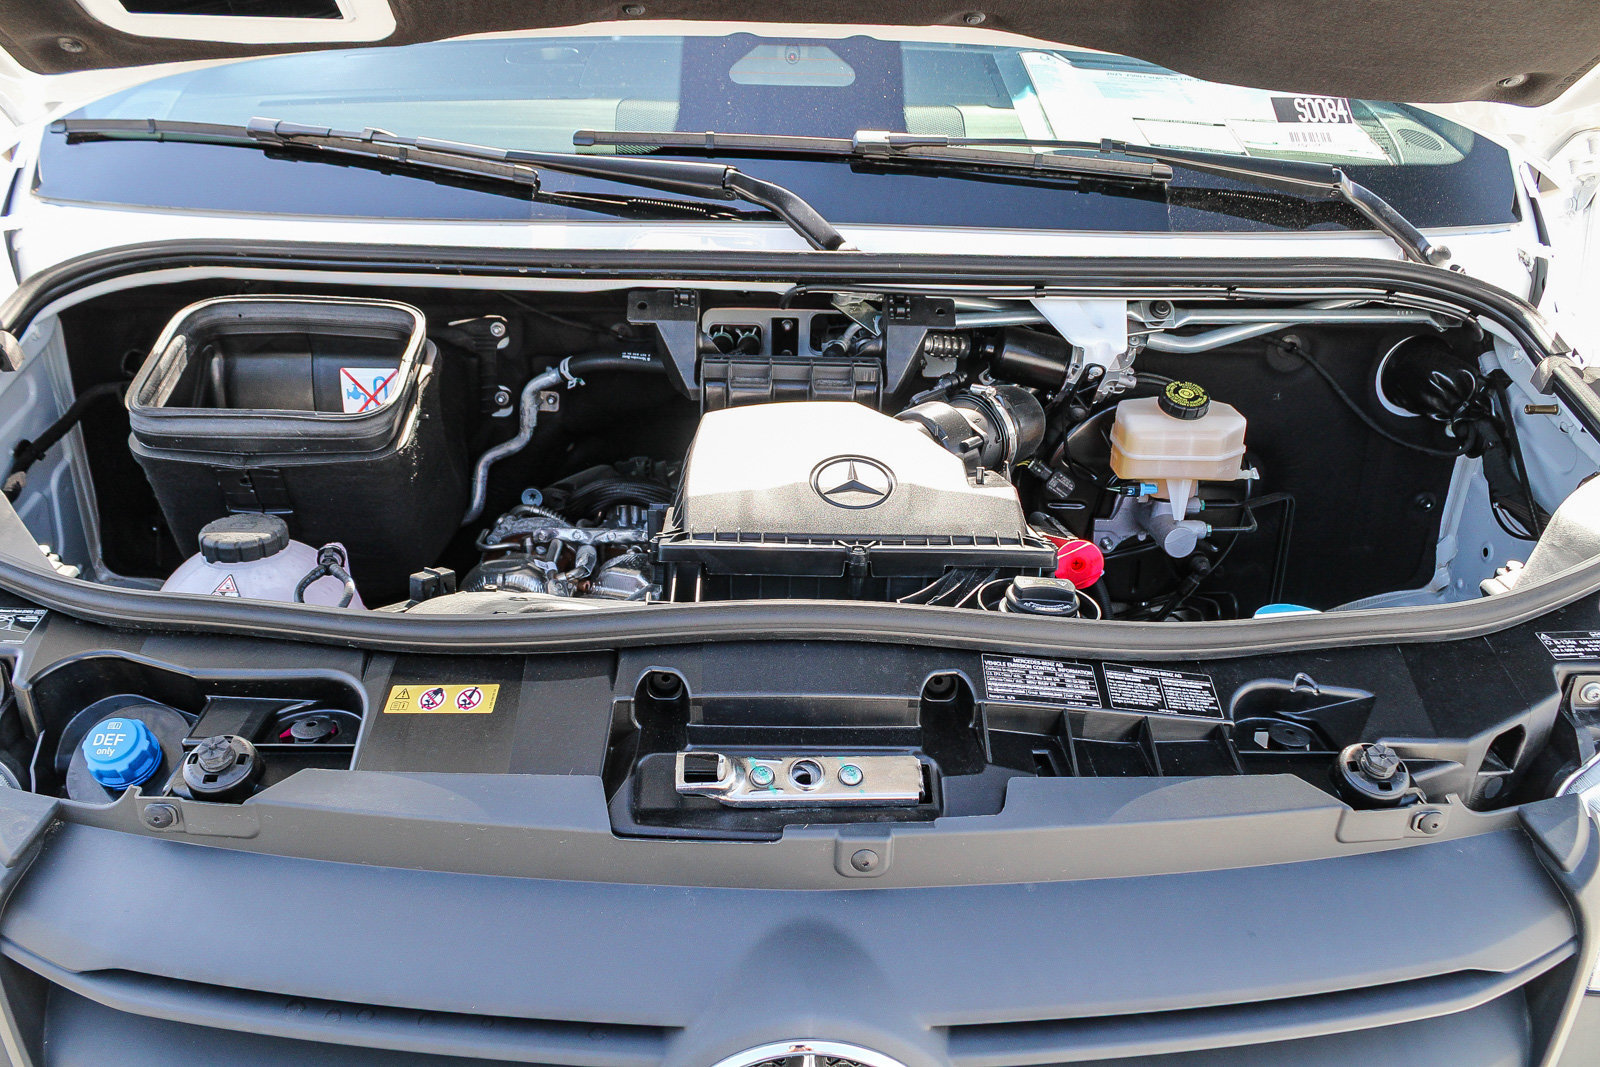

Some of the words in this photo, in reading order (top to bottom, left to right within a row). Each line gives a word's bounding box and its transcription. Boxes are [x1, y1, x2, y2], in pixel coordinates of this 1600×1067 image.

[1294, 98, 1348, 123] S0084
[1032, 664, 1056, 672] CONTROL
[92, 733, 127, 746] DEF
[96, 746, 115, 757] only
